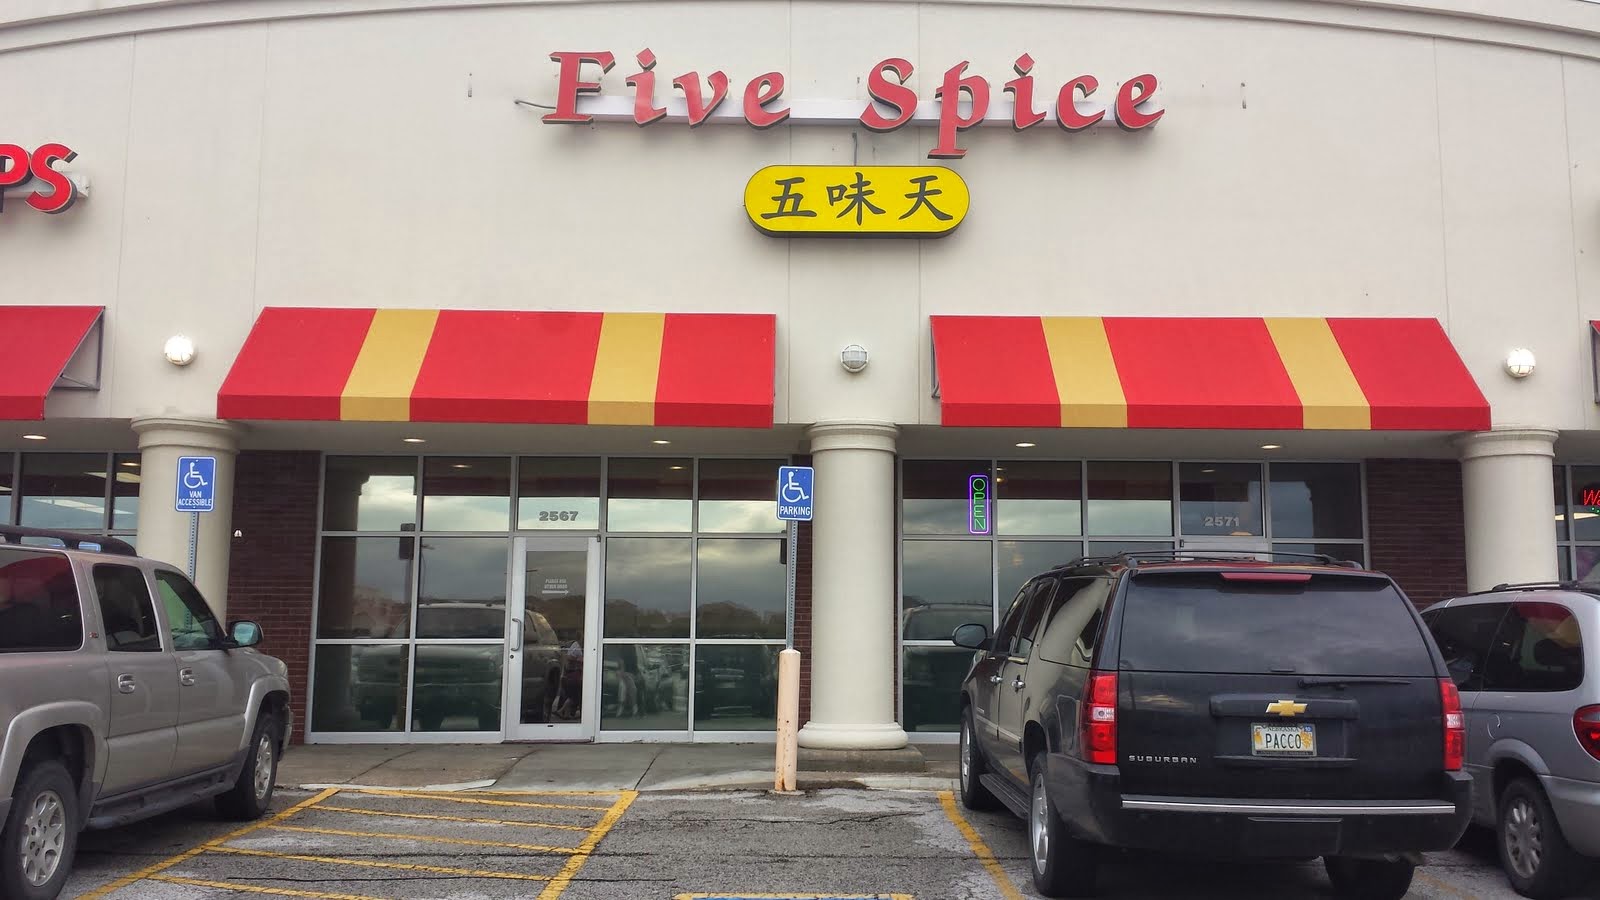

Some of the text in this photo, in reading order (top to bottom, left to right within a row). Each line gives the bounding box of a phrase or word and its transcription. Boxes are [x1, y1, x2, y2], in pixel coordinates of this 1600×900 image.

[541, 48, 1165, 159] Five Spice
[761, 172, 953, 226] 五味天
[189, 490, 202, 498] VAN
[178, 498, 212, 506] ACCESSIBLE
[972, 478, 986, 530] OPEN
[538, 510, 579, 522] 2567
[779, 505, 811, 516] PARKING
[1204, 516, 1240, 527] 2571
[1265, 733, 1302, 749] PACCO
[1128, 755, 1197, 764] SUBURBAN
